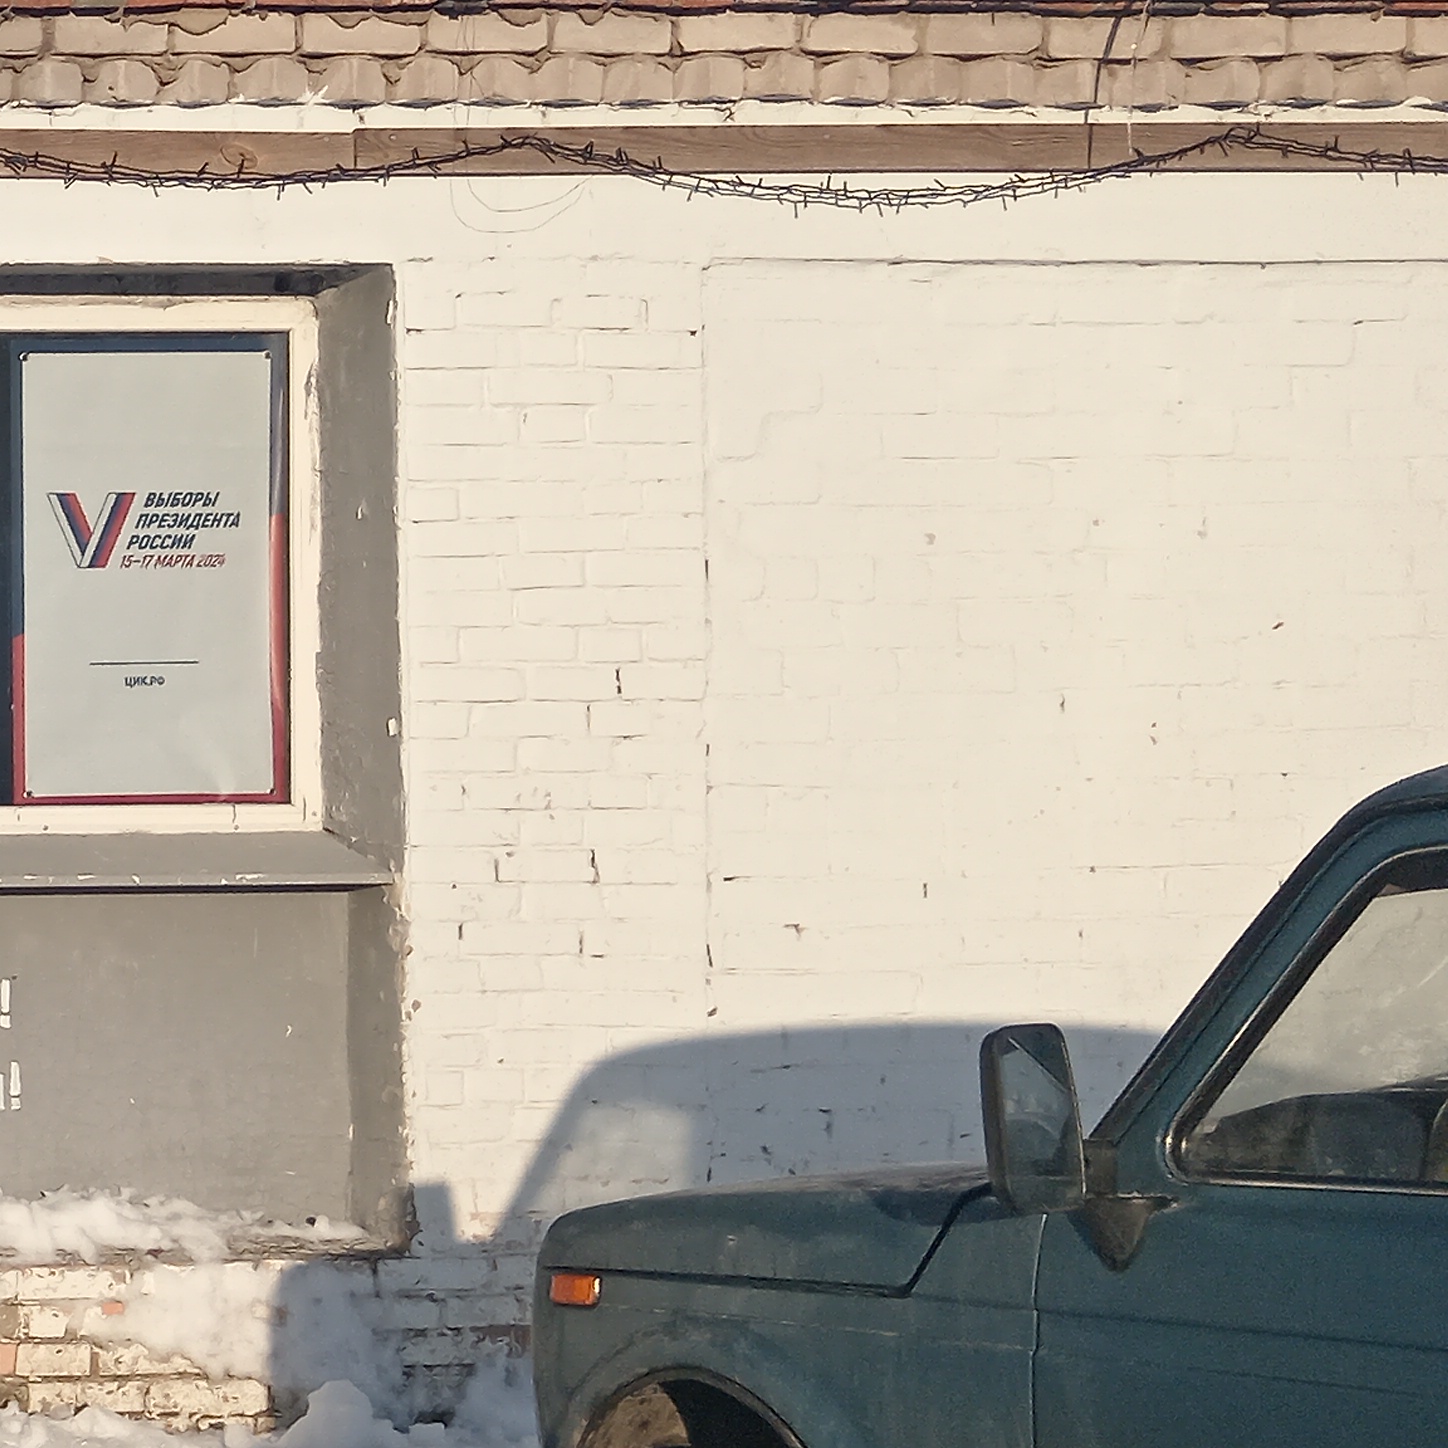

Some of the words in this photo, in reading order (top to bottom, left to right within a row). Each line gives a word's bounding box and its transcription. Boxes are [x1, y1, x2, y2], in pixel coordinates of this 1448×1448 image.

[144, 492, 220, 508] ВЫБОРЫ
[135, 512, 241, 530] ПРЕЗИДЕНТА
[126, 534, 196, 550] РОССИИ
[153, 554, 195, 569] МАРТА
[196, 554, 226, 568] 2024
